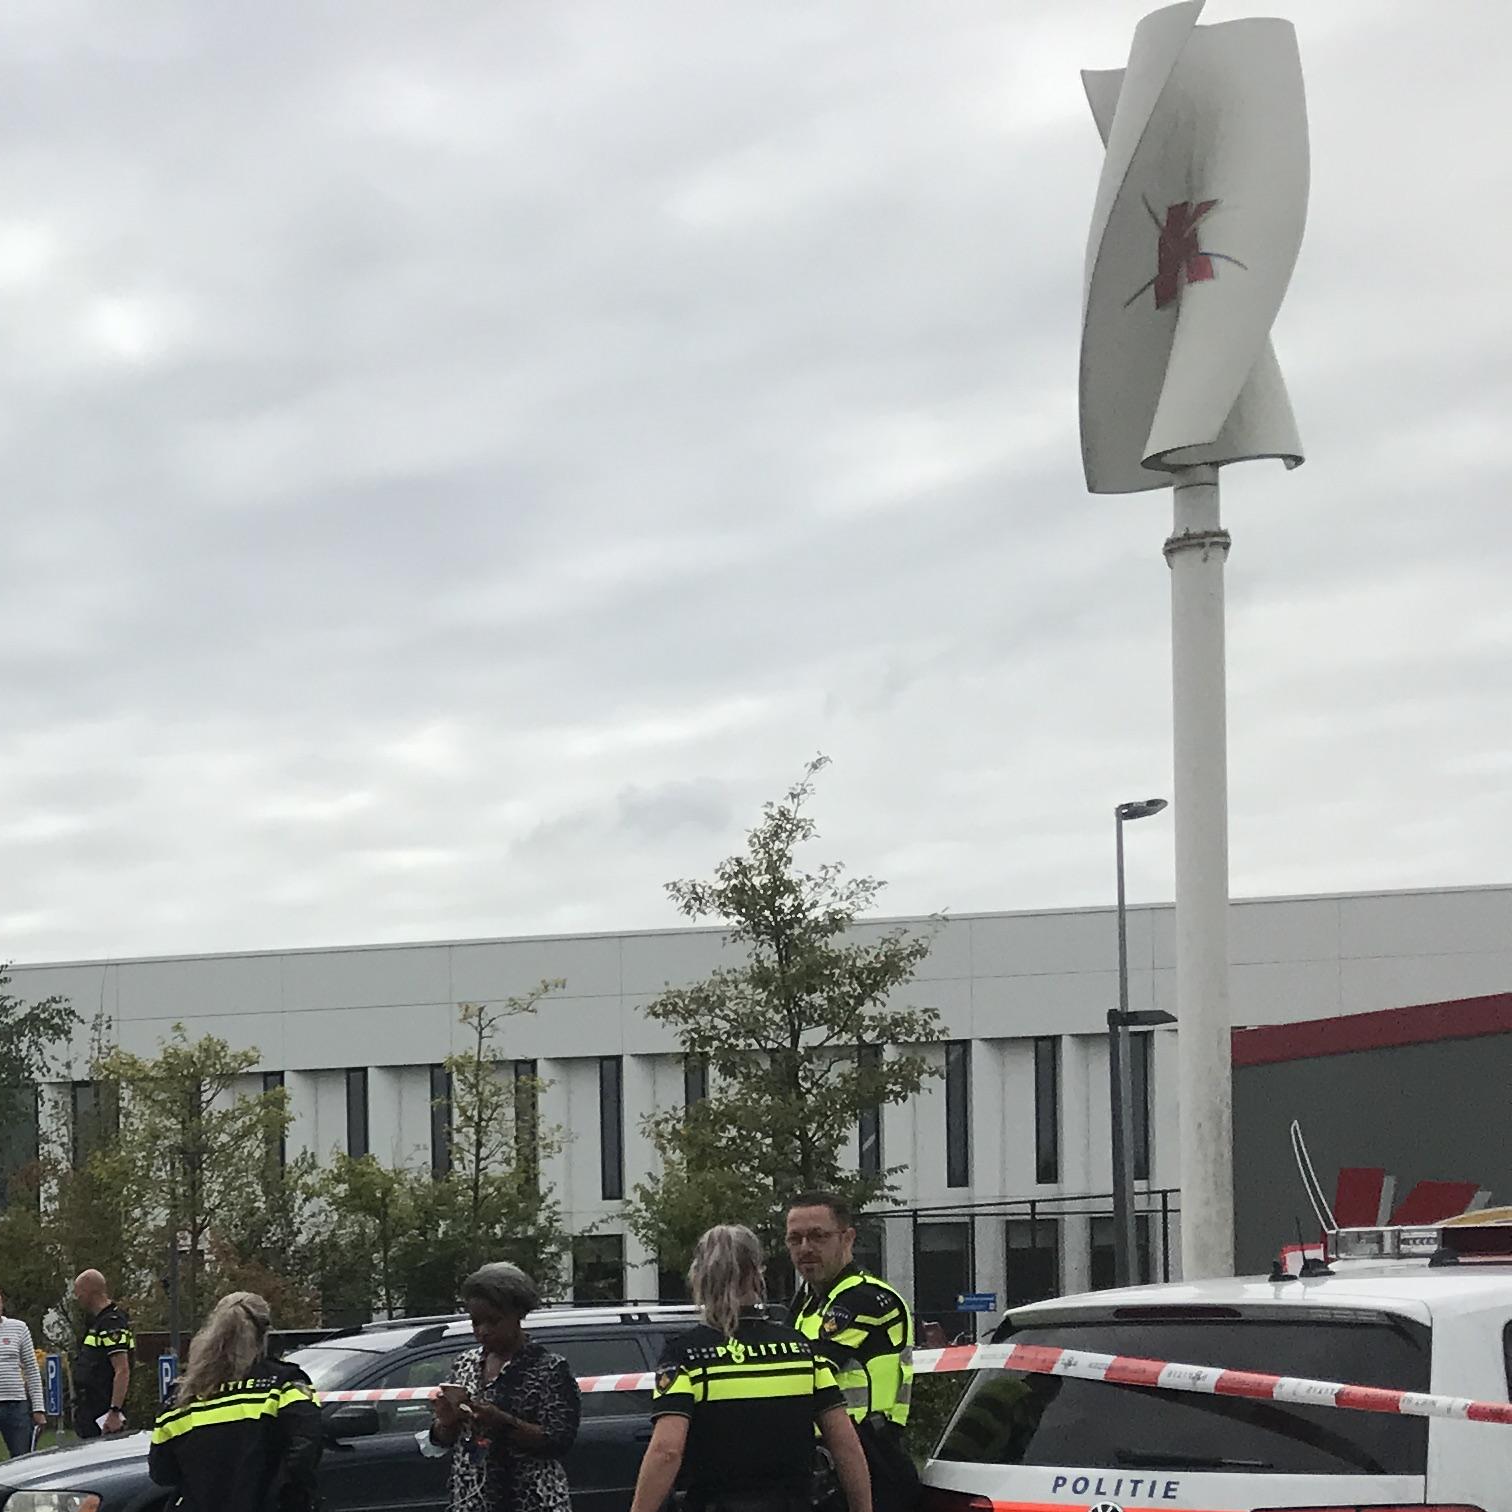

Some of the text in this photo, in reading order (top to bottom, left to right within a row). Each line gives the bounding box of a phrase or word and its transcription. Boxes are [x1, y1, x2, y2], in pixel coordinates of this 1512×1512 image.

[716, 1338, 801, 1363] POLITIE
[48, 1360, 56, 1390] P
[162, 1362, 172, 1395] P
[1052, 1475, 1180, 1499] POLITIE
